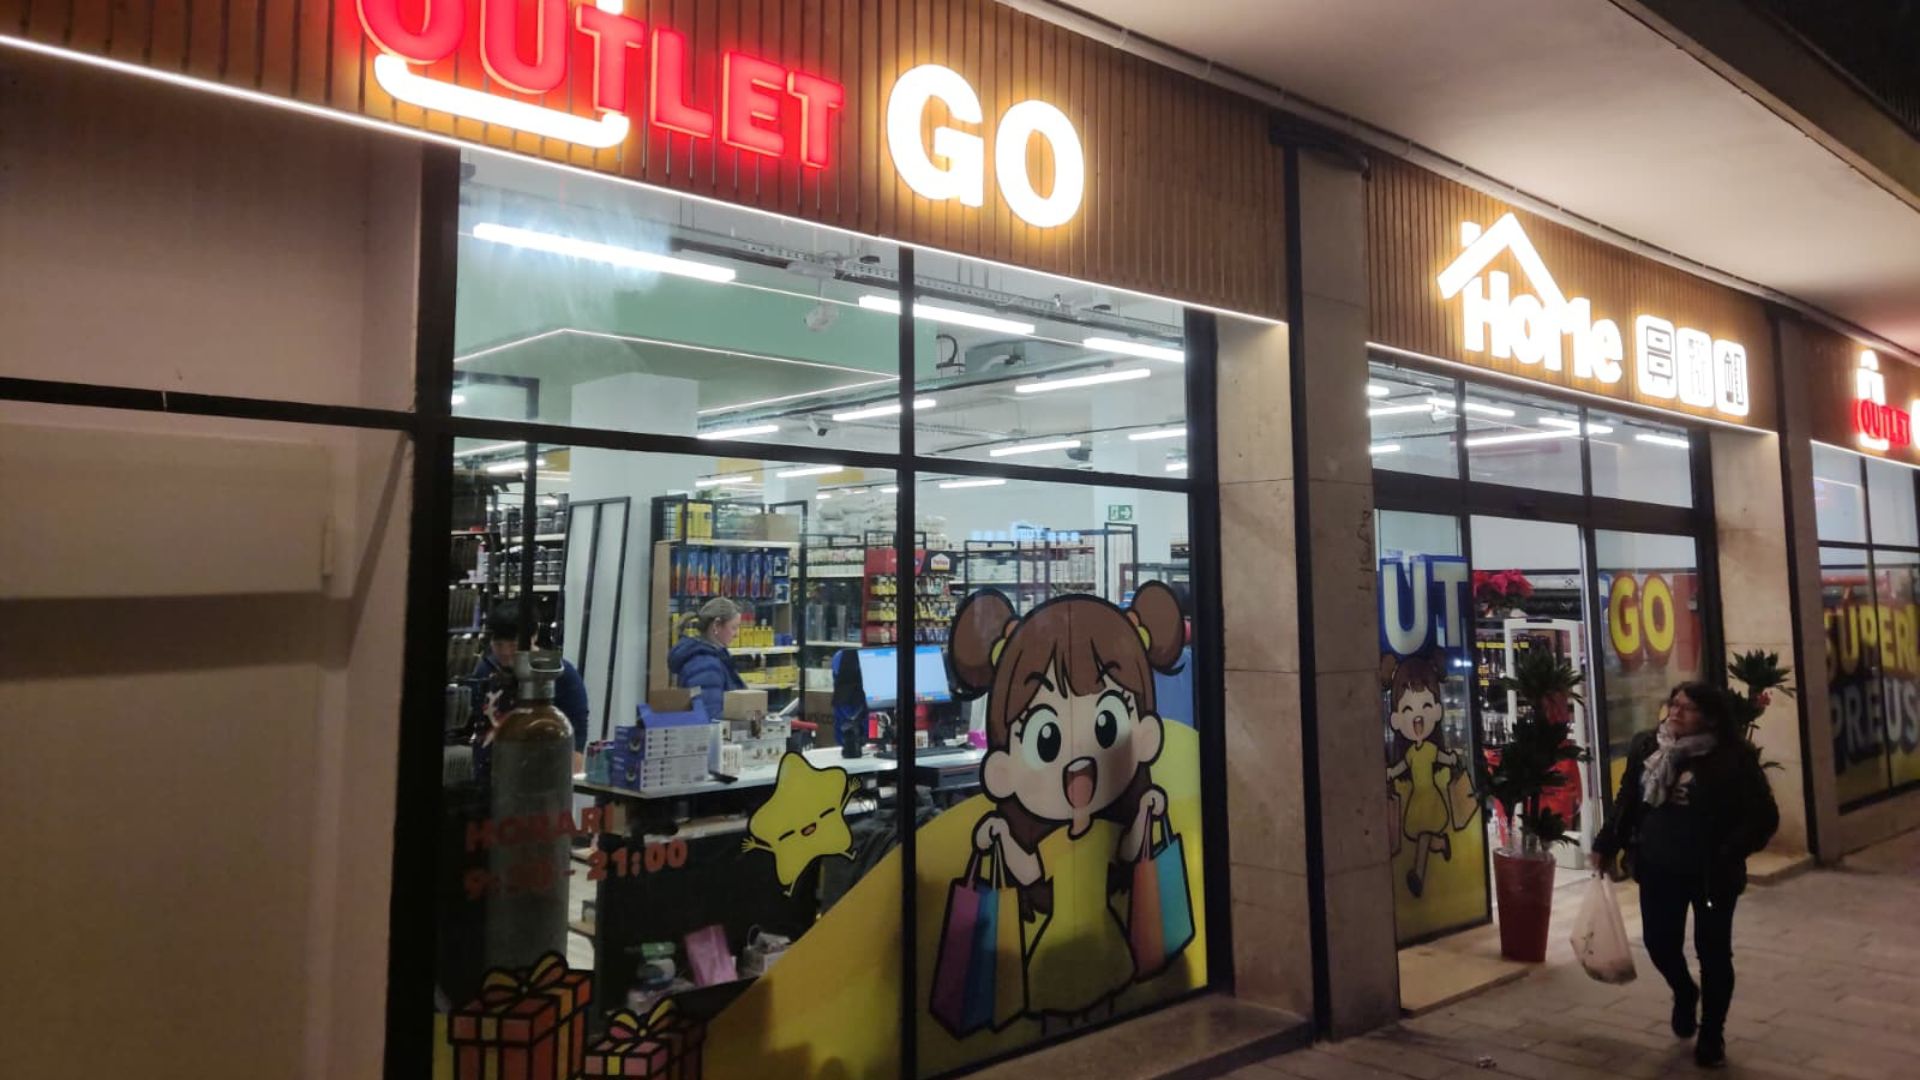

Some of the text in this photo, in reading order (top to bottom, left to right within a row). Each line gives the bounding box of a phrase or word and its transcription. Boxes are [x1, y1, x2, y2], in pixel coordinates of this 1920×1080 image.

[886, 63, 1085, 229] GO
[1609, 575, 1675, 655] GO
[586, 838, 689, 882] 21:00
